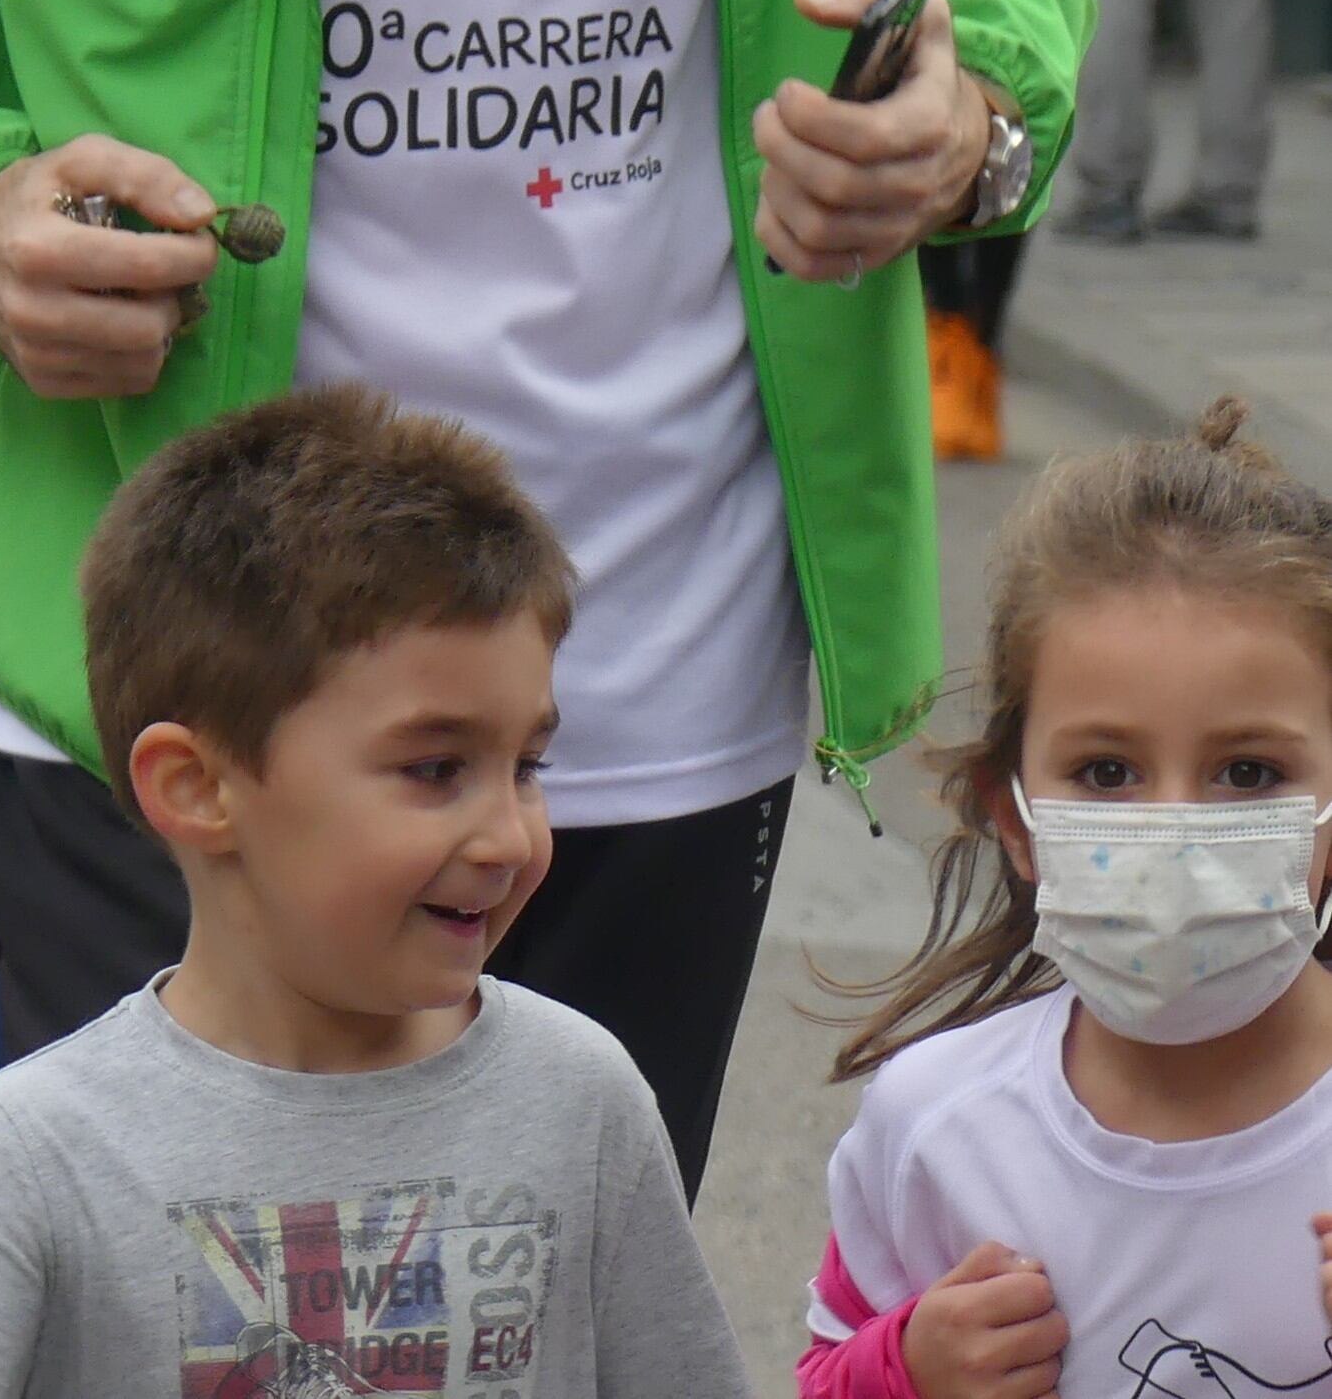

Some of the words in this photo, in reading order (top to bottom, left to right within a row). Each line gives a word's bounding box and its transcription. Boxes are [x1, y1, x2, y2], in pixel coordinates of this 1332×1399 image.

[413, 5, 673, 74] CARRERA
[570, 171, 622, 191] Cruz
[625, 154, 663, 182] Roja
[279, 1260, 445, 1316] TOWER
[470, 1322, 535, 1374] EC4
